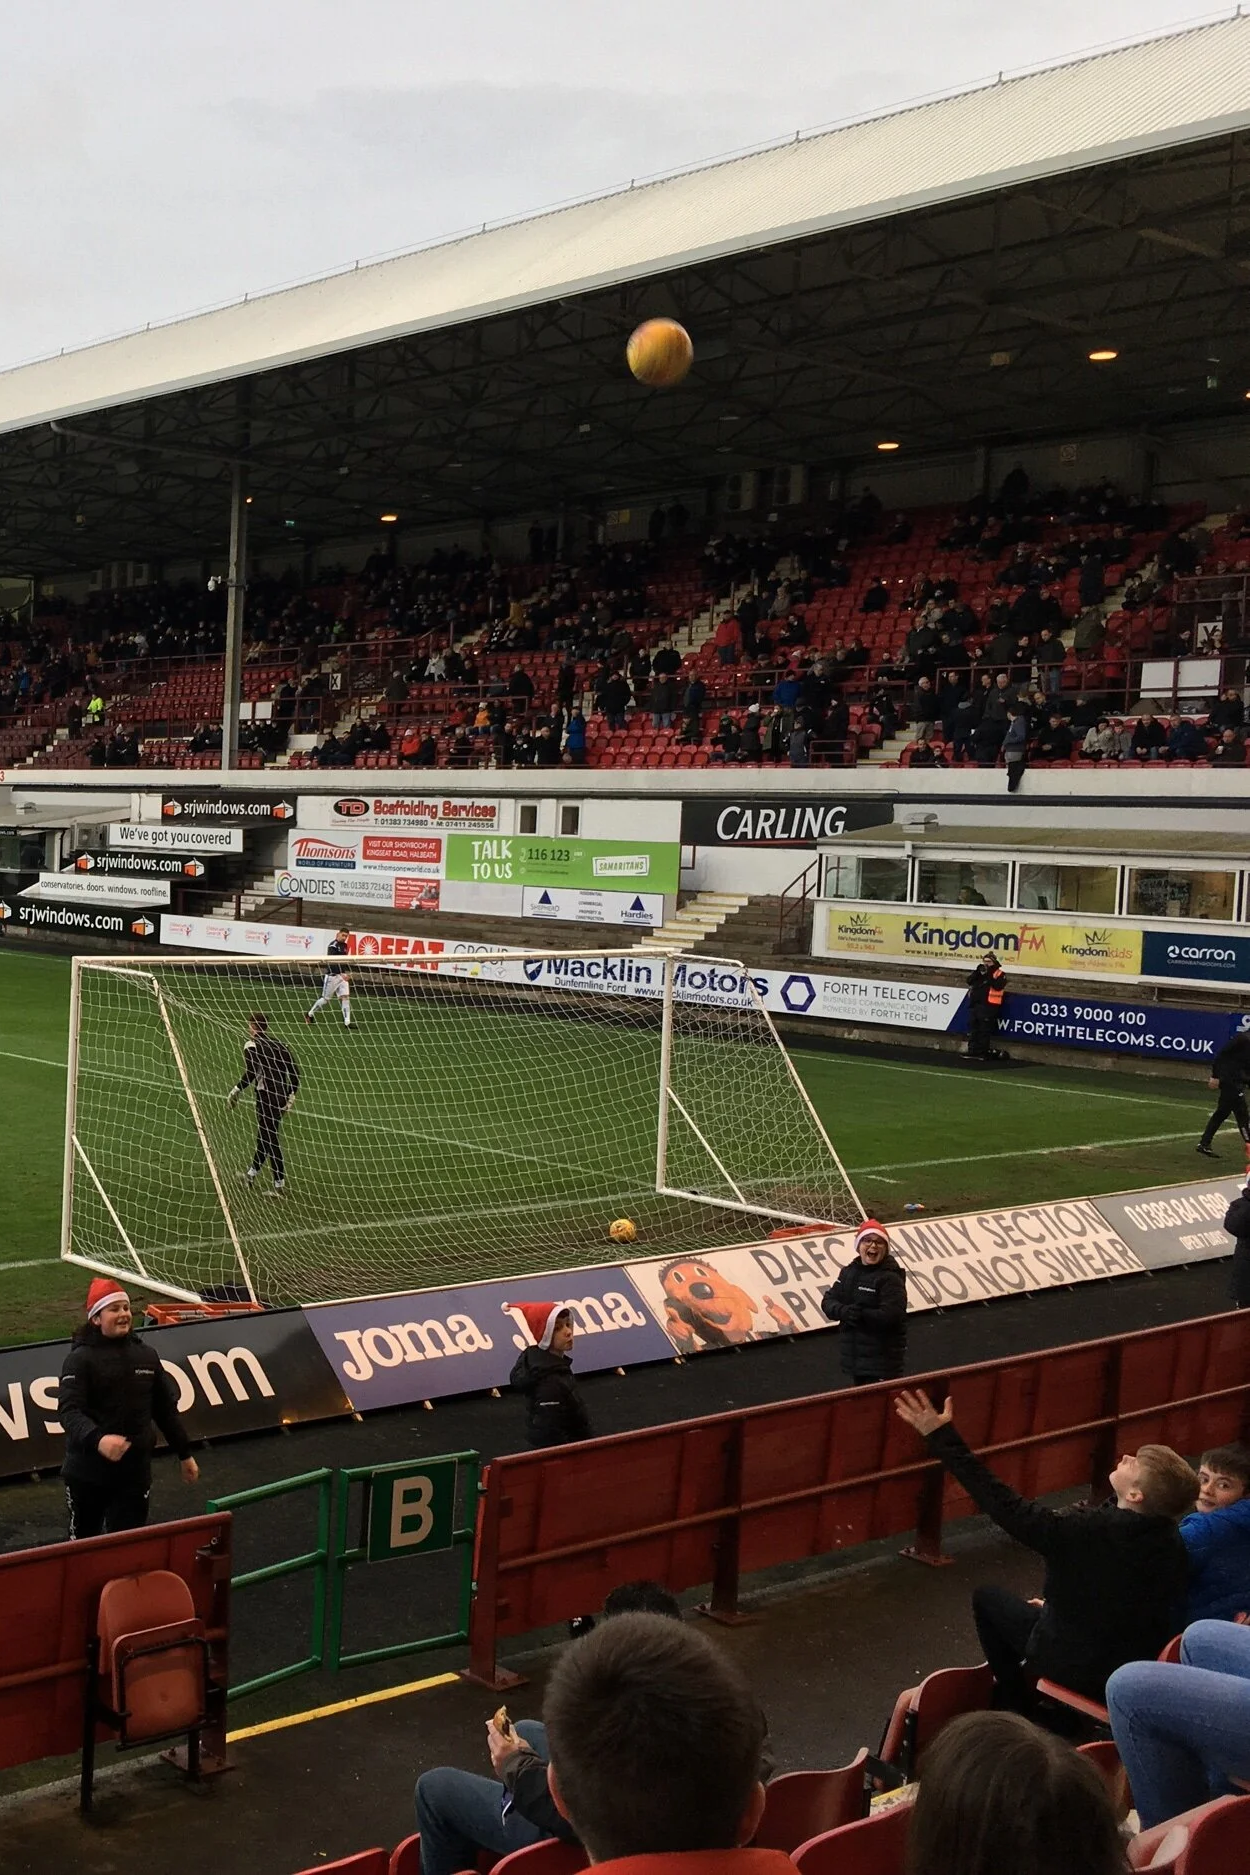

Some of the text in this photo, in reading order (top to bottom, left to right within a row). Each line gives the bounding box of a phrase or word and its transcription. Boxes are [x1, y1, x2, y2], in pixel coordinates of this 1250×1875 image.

[183, 800, 271, 818] srjwindows.com
[373, 799, 438, 819] Scaffolding
[442, 800, 496, 818] Services
[716, 805, 848, 841] CARLING
[119, 827, 232, 846] We've got you covered
[381, 840, 394, 848] OUR
[394, 841, 428, 849] SHOWROOM
[428, 842, 436, 850] AT
[295, 844, 357, 860] Thomsons
[471, 839, 512, 860] TALK
[527, 848, 547, 861] 116
[549, 849, 570, 862] 123
[96, 854, 182, 873] srjwindows.com
[470, 863, 490, 880] TO
[494, 862, 513, 879] US
[598, 861, 644, 871] SAMARITANS
[279, 876, 336, 896] CONDIES
[19, 905, 123, 931] srjwindows.com
[620, 910, 654, 920] Hardies
[1181, 946, 1236, 962] carron
[546, 956, 769, 998] Macklin Motors
[554, 976, 754, 1008] Dunfermline Ford www.mcklinmotors.co.uk
[822, 981, 951, 1006] FORTH TELECOMS
[870, 1008, 902, 1020] FORTH
[903, 1012, 928, 1022] TECH
[1031, 1002, 1147, 1026] 0333 9000 100
[997, 1018, 1214, 1054] W.FORTHTELECOMS.CO.UK
[1123, 1200, 1182, 1232] 01383
[749, 1202, 1112, 1287] DAFC AMILY SECTION
[905, 1238, 1144, 1305] DO NOT SWEAR
[502, 1291, 647, 1352] Jma
[333, 1313, 494, 1382] Joma
[389, 1475, 434, 1549] B
